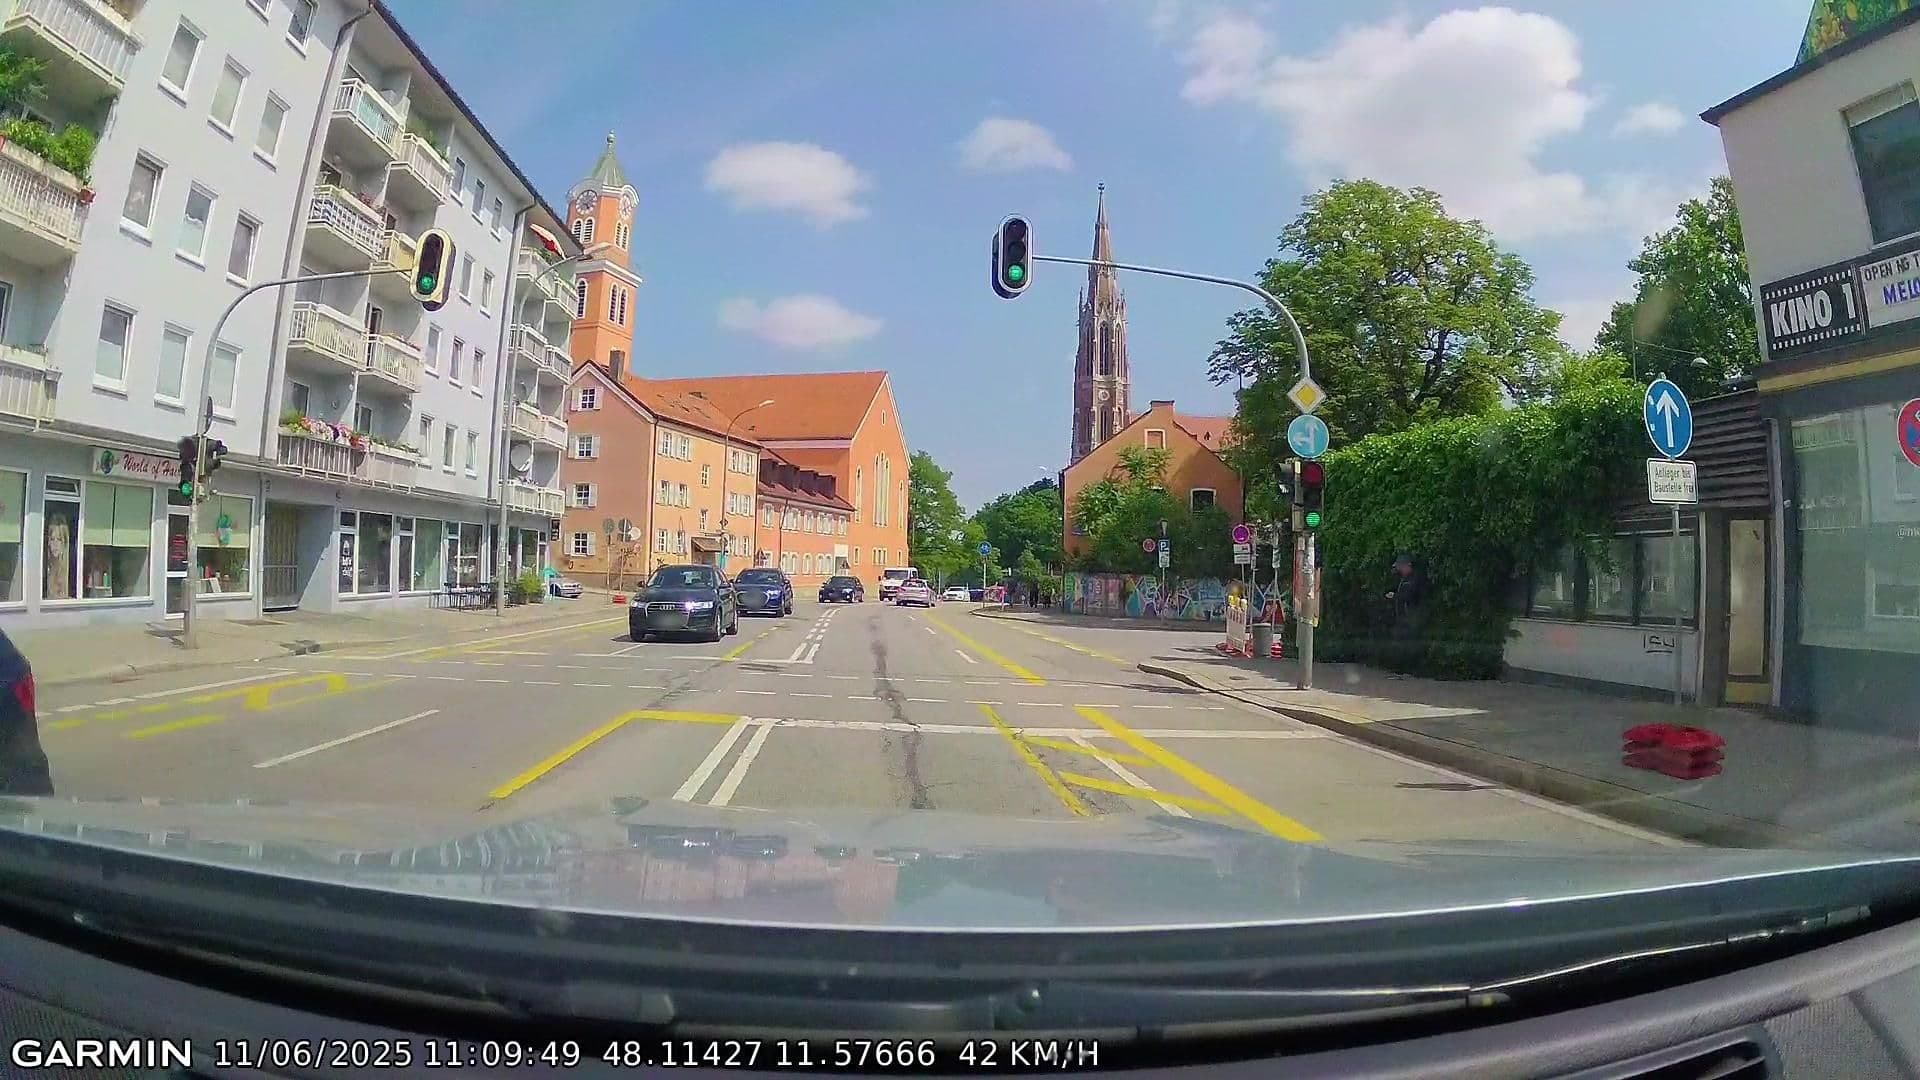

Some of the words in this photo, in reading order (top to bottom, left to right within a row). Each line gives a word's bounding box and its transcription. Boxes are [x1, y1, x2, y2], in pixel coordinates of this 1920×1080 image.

[1770, 289, 1833, 338] KINO
[1841, 282, 1857, 320] 1
[123, 454, 148, 473] World
[151, 459, 161, 479] of
[1654, 481, 1682, 493] Baustelle
